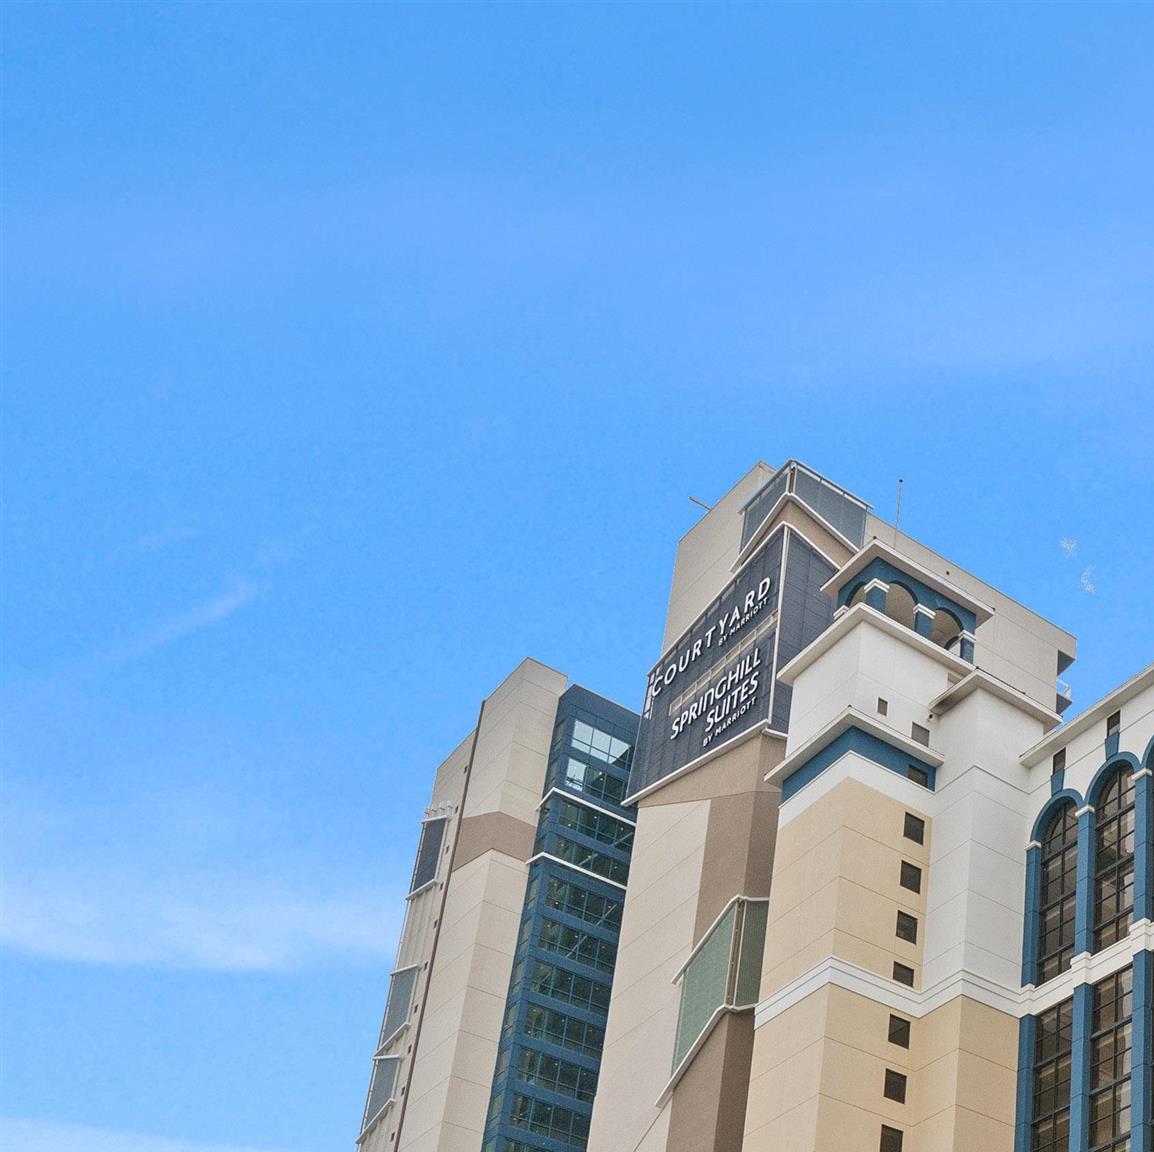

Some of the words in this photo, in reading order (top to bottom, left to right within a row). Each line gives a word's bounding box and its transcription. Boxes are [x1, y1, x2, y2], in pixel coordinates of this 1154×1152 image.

[651, 577, 772, 698] COURTYARD
[717, 633, 728, 646] BY
[729, 596, 769, 637] MARRIOTT
[669, 648, 762, 740] SPRINGHILL
[702, 734, 714, 748] BY
[715, 696, 756, 737] MARRIOTT
[705, 672, 760, 734] SUITES
